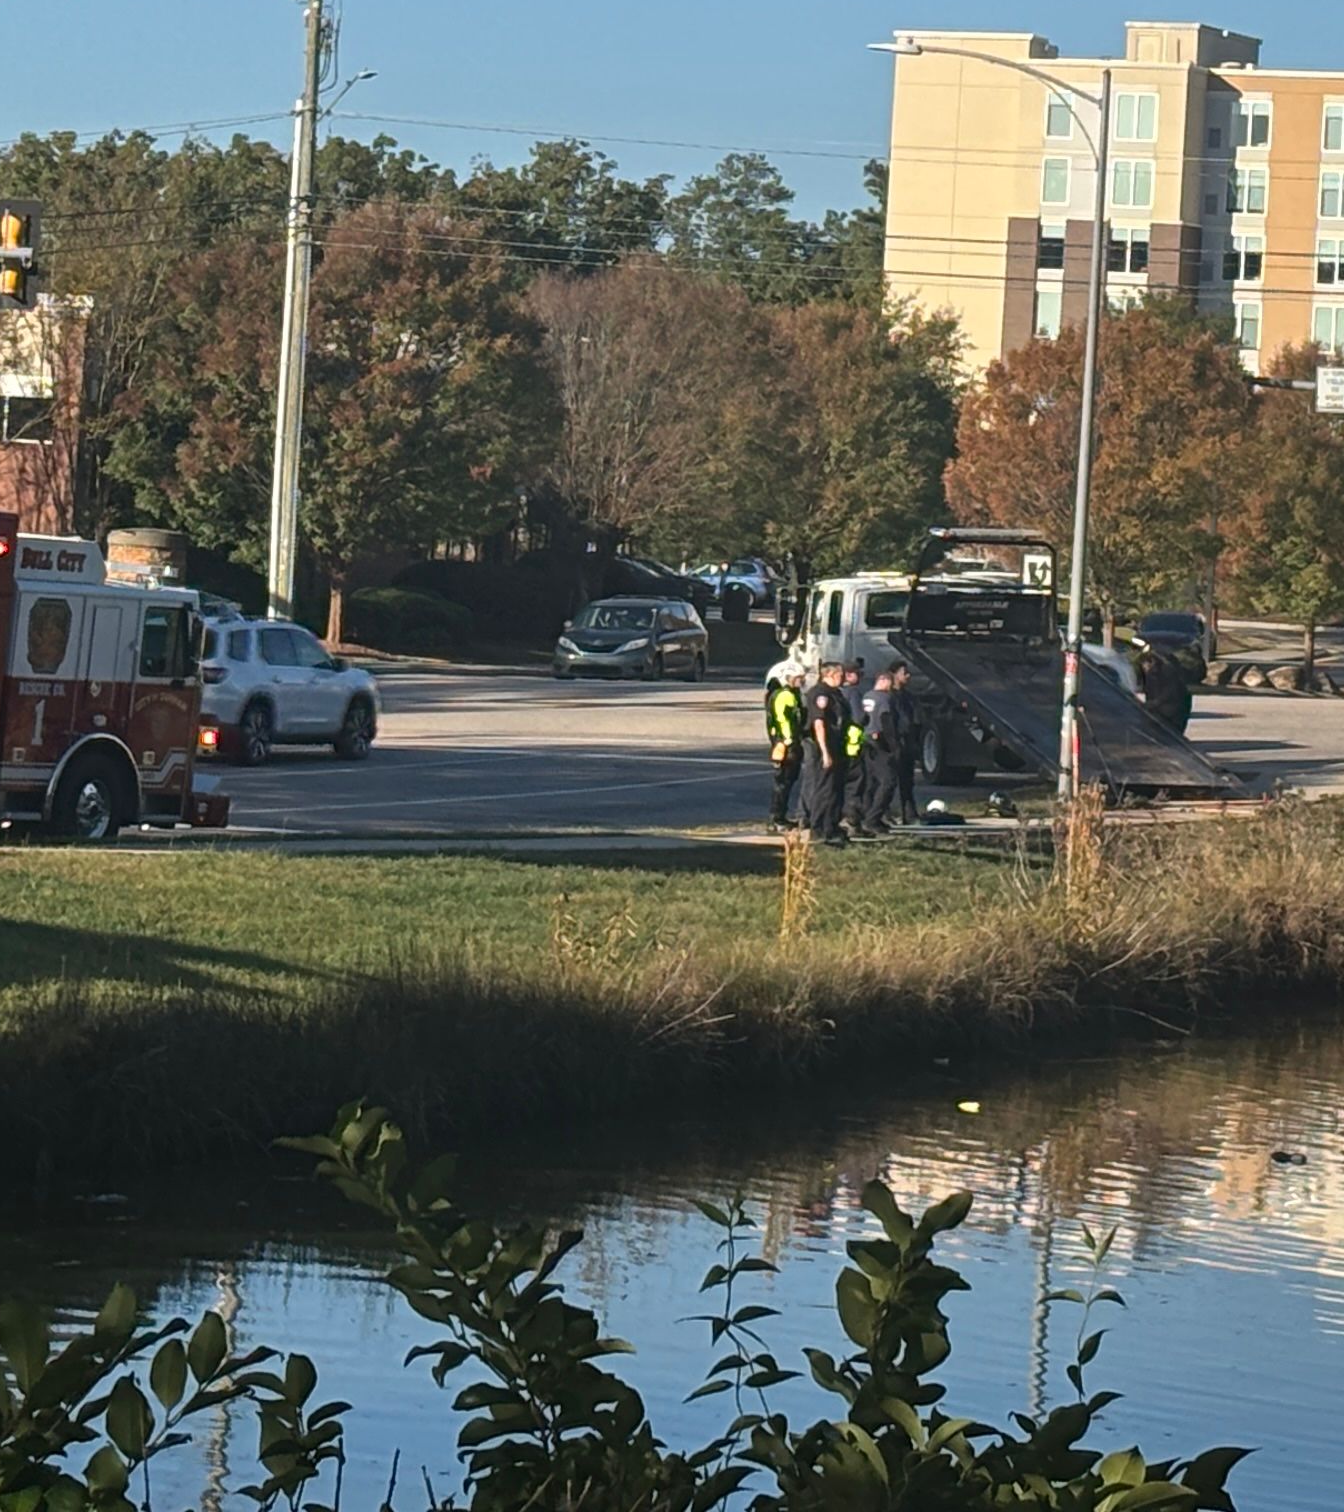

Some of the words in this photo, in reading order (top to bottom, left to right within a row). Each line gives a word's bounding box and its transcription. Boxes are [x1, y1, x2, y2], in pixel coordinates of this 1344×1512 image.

[21, 547, 53, 570] BULL
[58, 549, 86, 573] CITY
[31, 699, 46, 745] 1
